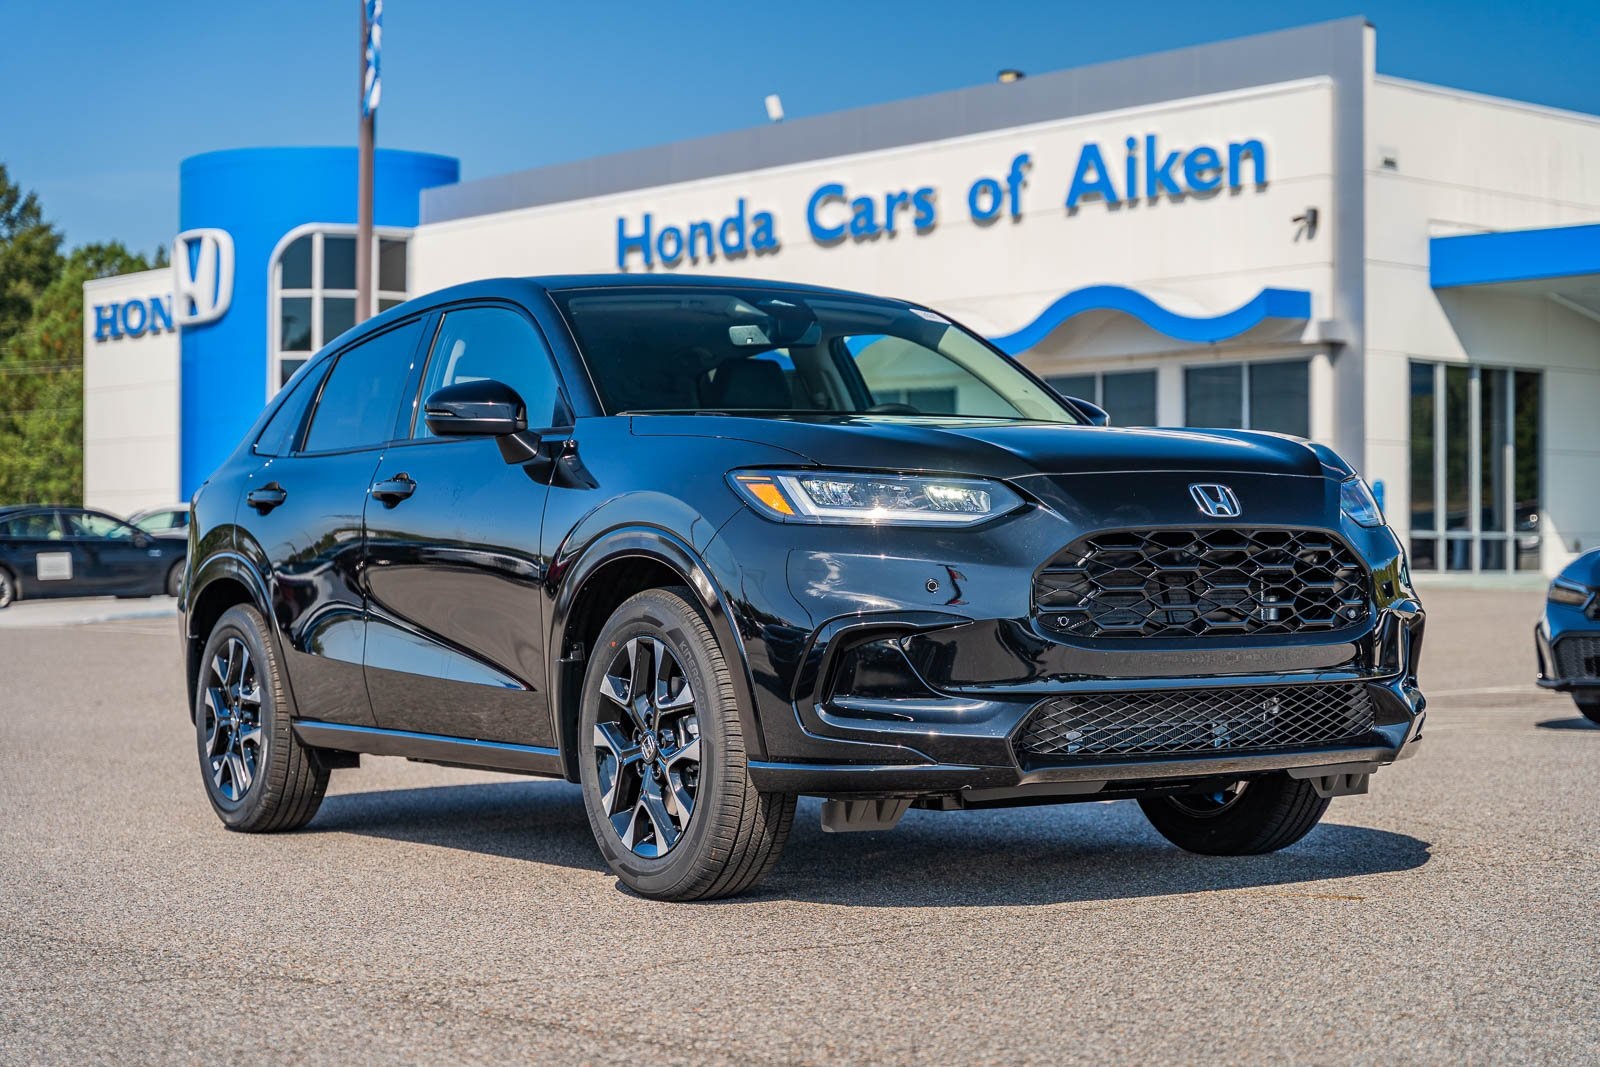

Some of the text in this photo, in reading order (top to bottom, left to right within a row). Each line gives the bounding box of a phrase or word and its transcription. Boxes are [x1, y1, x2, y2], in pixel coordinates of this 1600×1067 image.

[617, 134, 1265, 268] Honda Cars of Aiken
